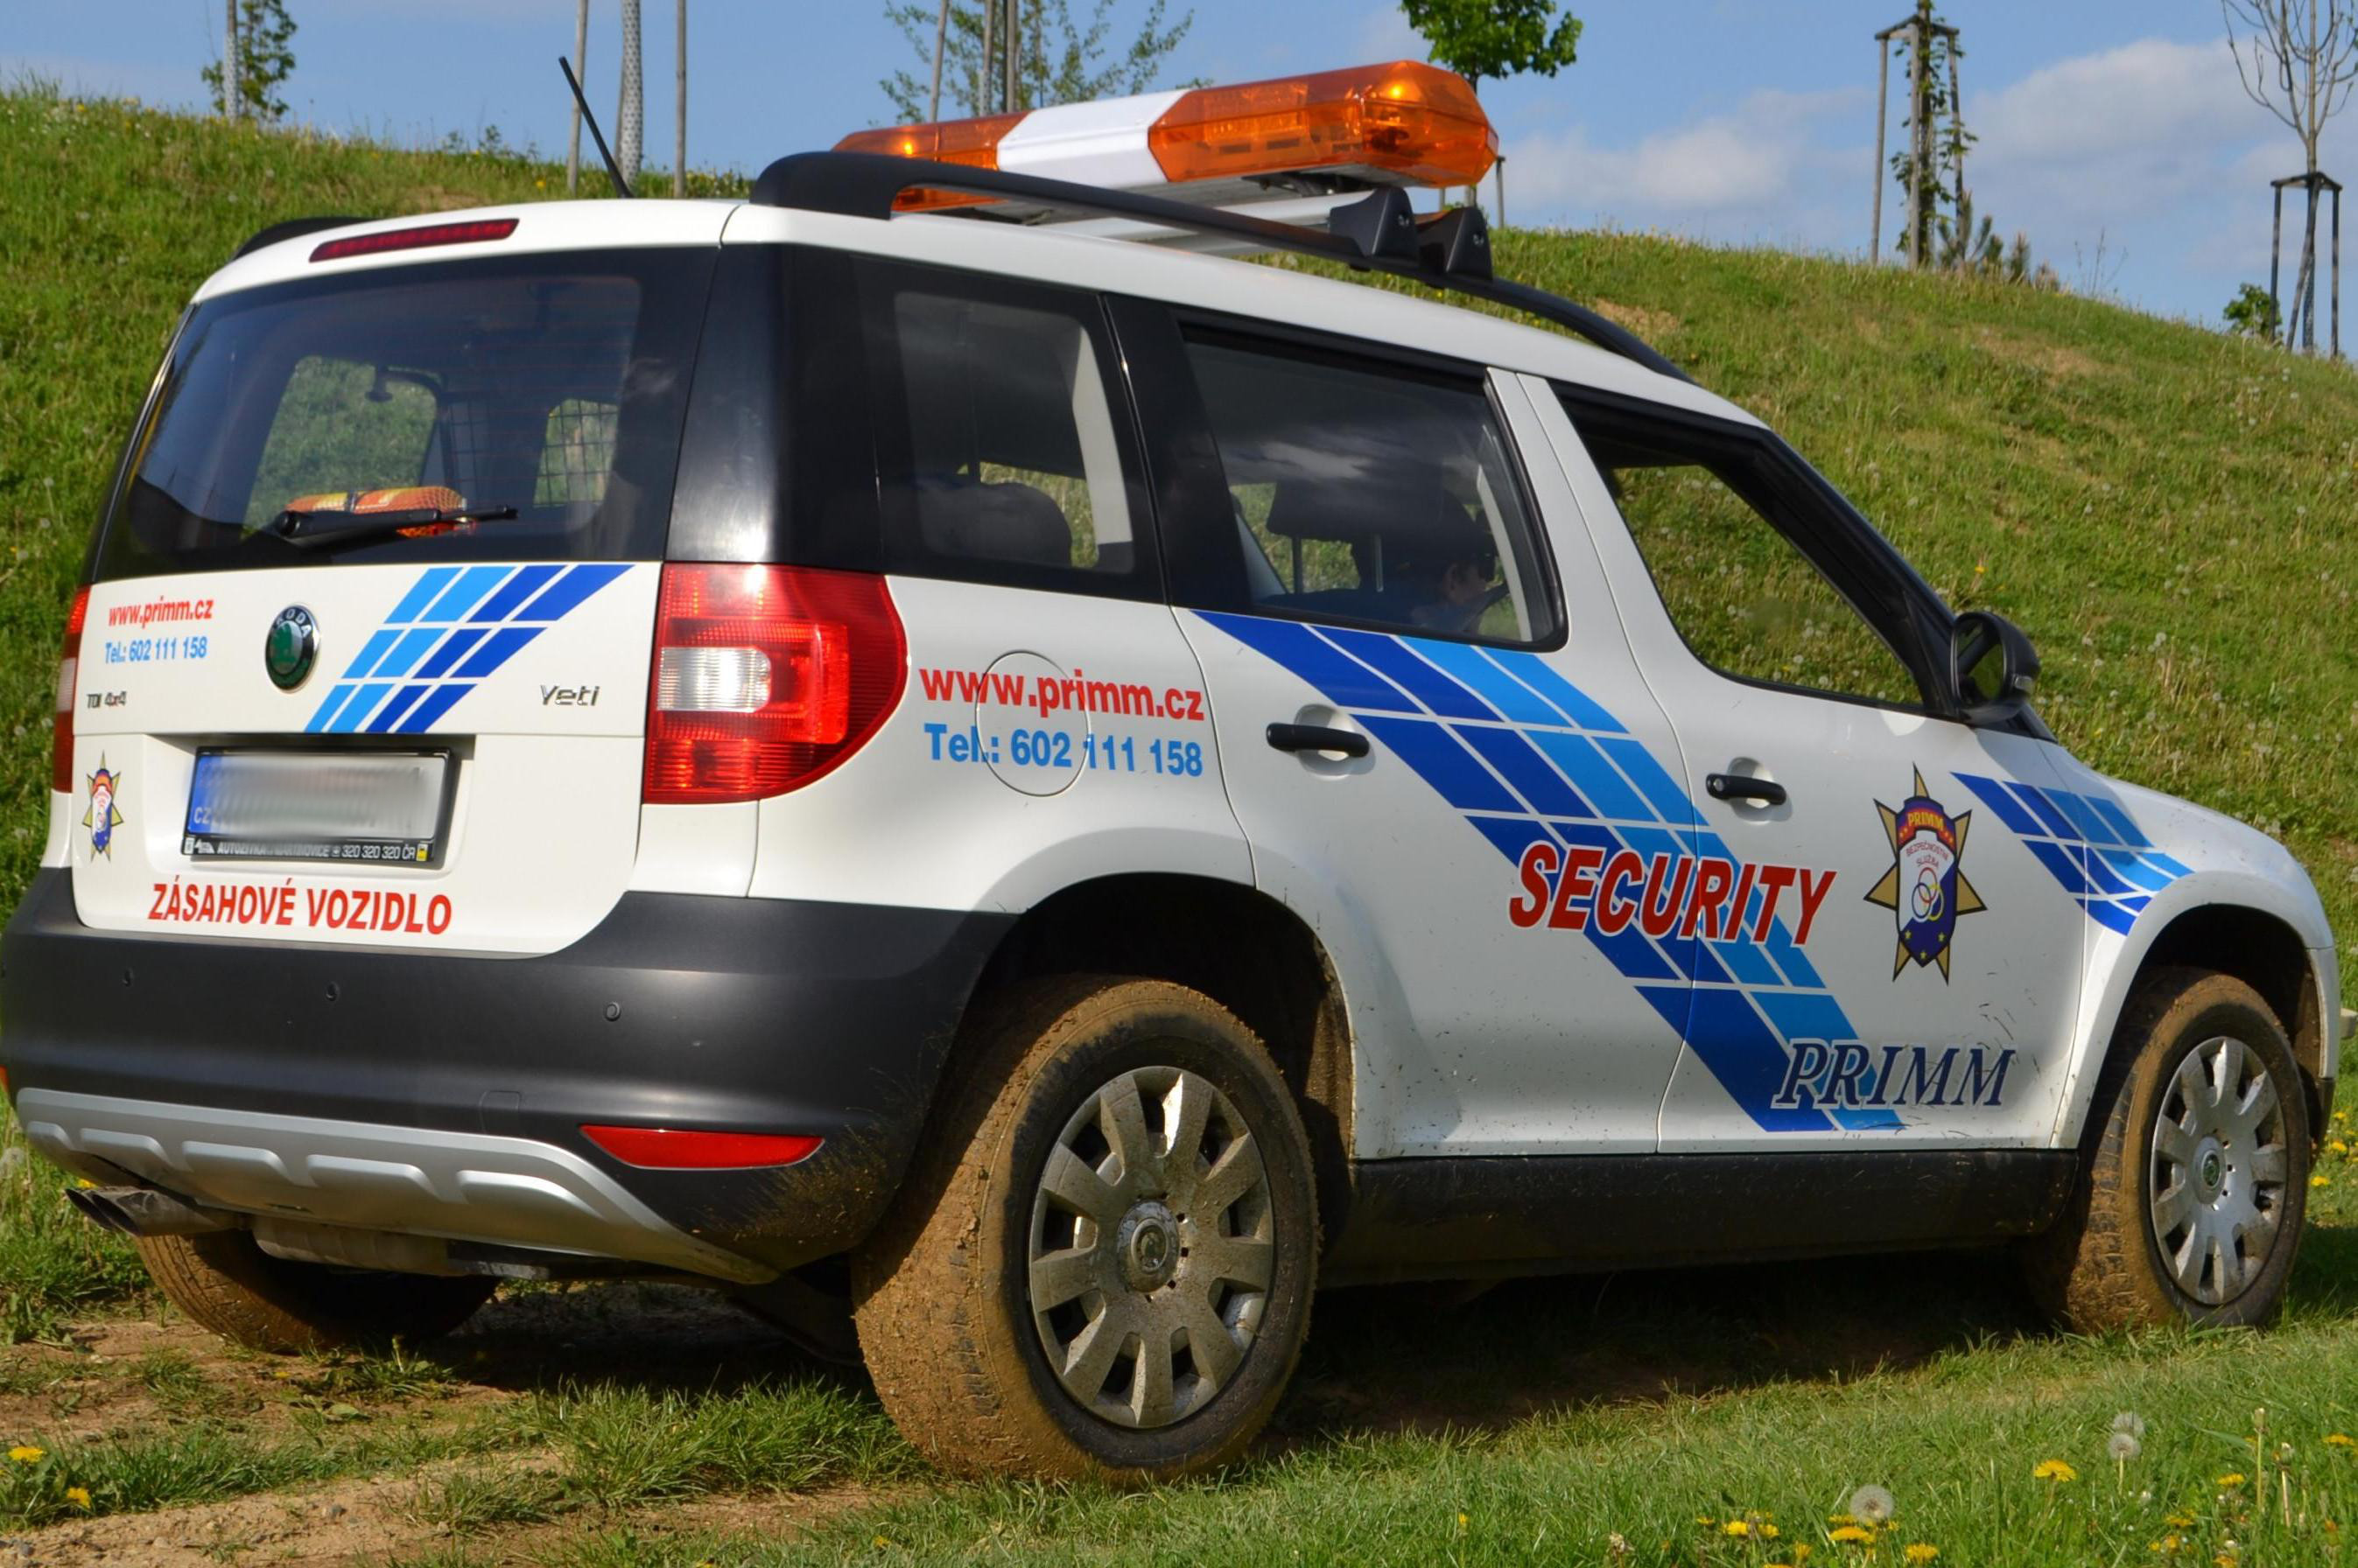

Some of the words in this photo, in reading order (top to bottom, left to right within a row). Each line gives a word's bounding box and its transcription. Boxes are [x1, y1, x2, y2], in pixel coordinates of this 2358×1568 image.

[109, 595, 214, 628] www.primm.cz
[105, 641, 126, 663] Tel.:
[129, 639, 152, 662] 602
[156, 637, 177, 660] 111
[183, 636, 207, 659] 158
[104, 690, 127, 706] 4x4
[540, 684, 600, 706] Yeti
[919, 668, 1204, 721] www.primm.cz
[924, 723, 1000, 764] Tel.:
[1011, 729, 1072, 767] 602
[1083, 733, 1135, 772] 111
[1149, 738, 1203, 777] 158
[193, 806, 212, 824] CZ
[1908, 811, 1944, 831] PRIMM
[361, 845, 381, 858] 320
[382, 846, 401, 859] 320
[148, 875, 295, 928] ZÁSAHOVÉ
[307, 887, 453, 934] VOZIDLO
[1508, 842, 1837, 947] SECURITY
[1772, 1040, 2016, 1108] PRIMM
